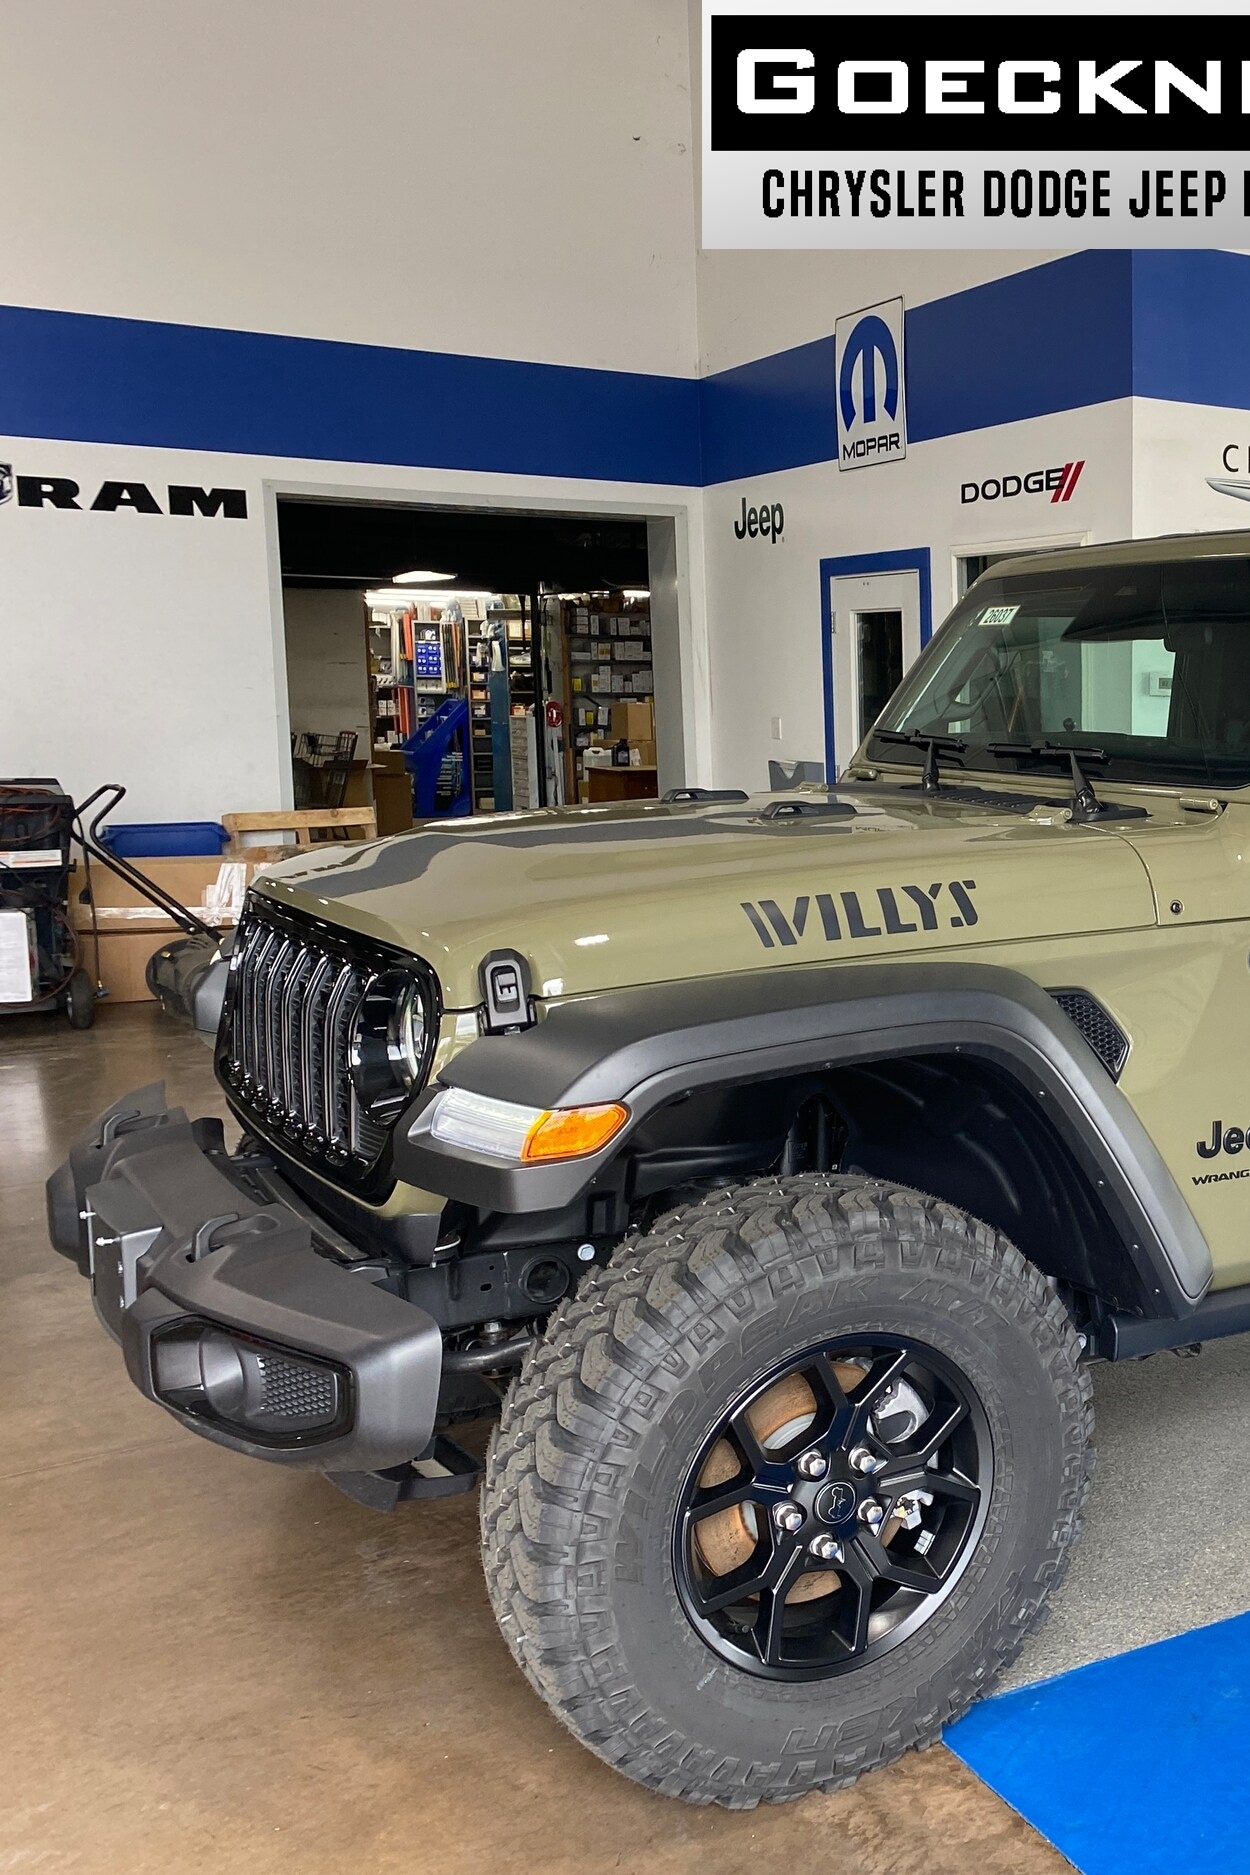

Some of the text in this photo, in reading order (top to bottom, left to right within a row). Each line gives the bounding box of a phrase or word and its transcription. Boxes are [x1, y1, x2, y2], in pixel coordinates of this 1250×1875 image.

[842, 432, 901, 461] MOPAR
[16, 475, 248, 520] RAM
[961, 467, 1066, 504] DODGE
[734, 497, 785, 545] Jeep
[740, 880, 979, 948] WILLYS
